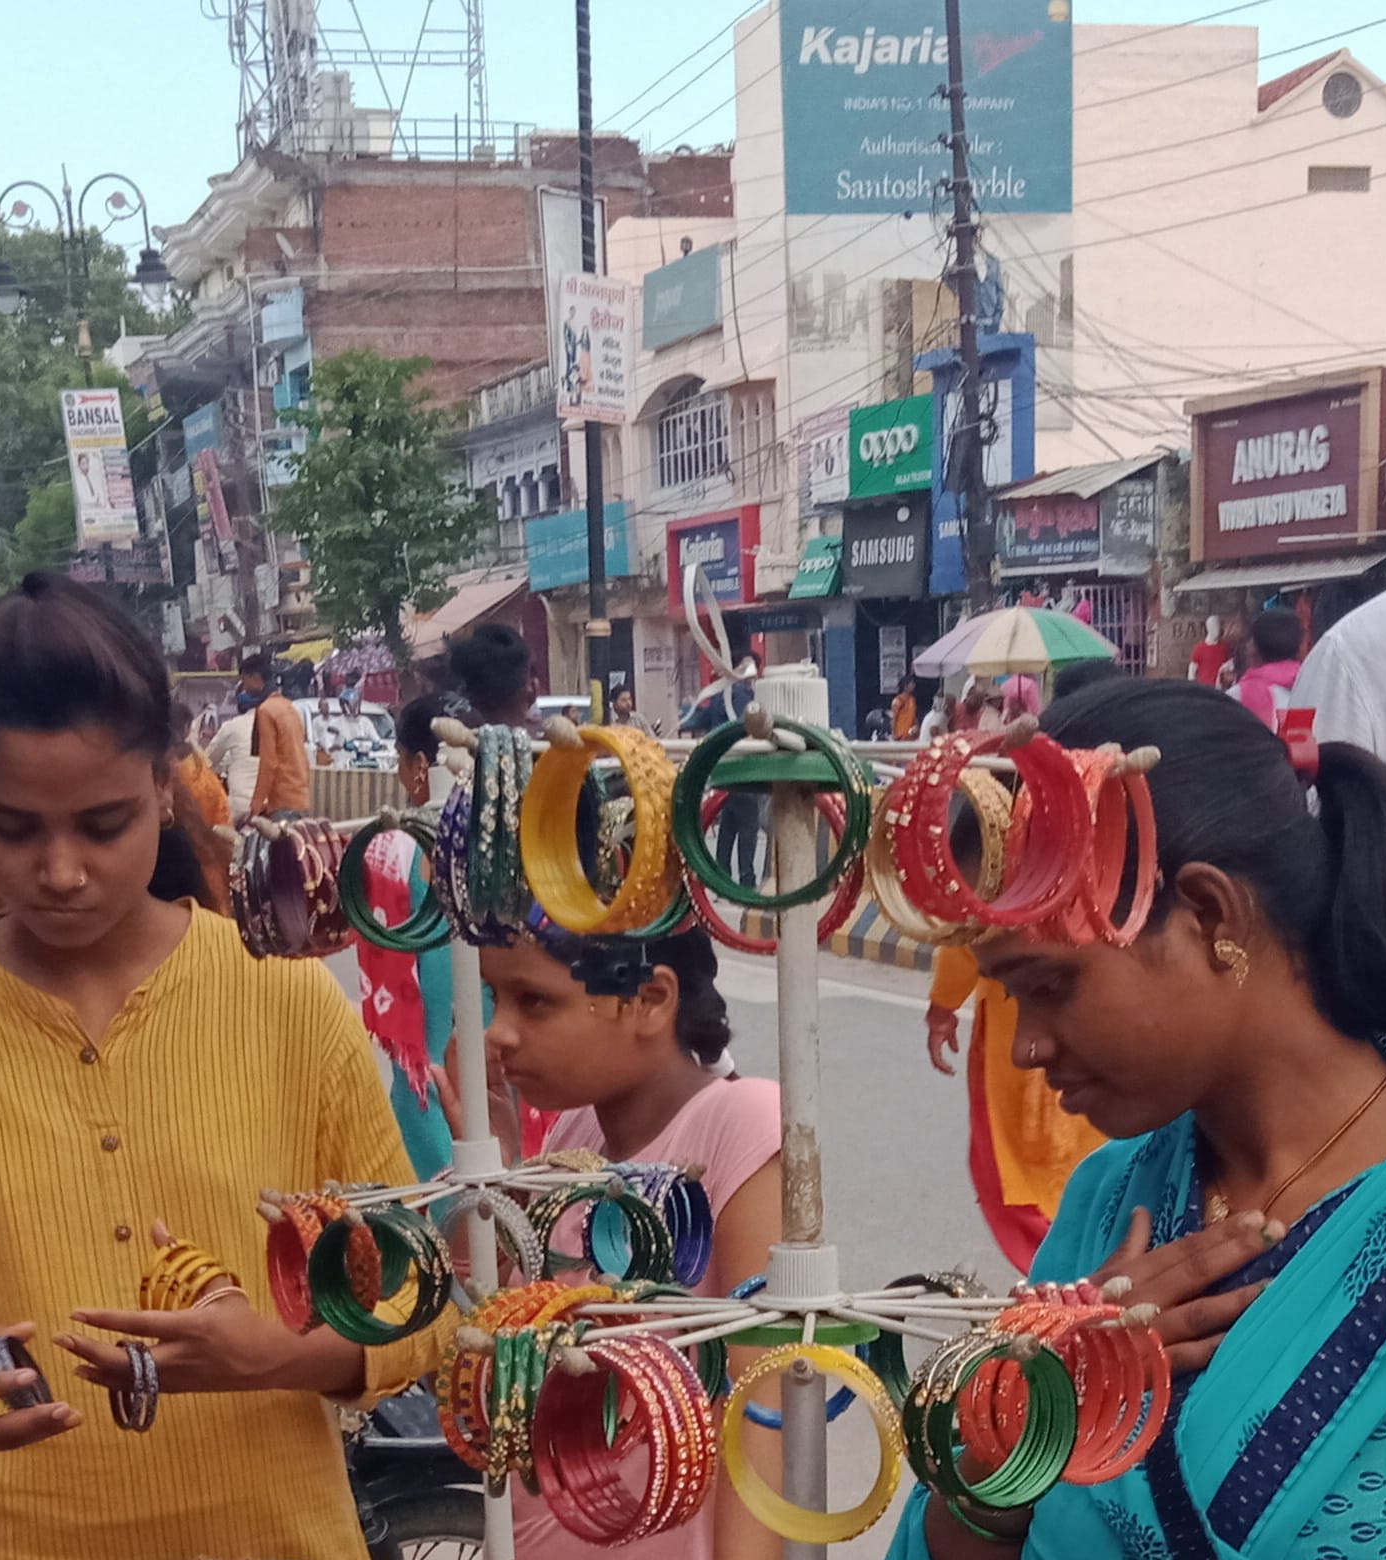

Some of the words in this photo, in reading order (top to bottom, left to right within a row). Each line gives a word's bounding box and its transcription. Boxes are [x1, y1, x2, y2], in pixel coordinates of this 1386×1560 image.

[798, 25, 949, 75] Kajaria
[962, 98, 1015, 112] OMPANY
[836, 166, 931, 200] Santosh
[67, 406, 119, 427] BANSAL
[860, 424, 919, 468] oppo
[1231, 424, 1331, 486] ANURAG
[679, 532, 724, 568] Kajaria
[851, 535, 914, 568] SAMSUNG
